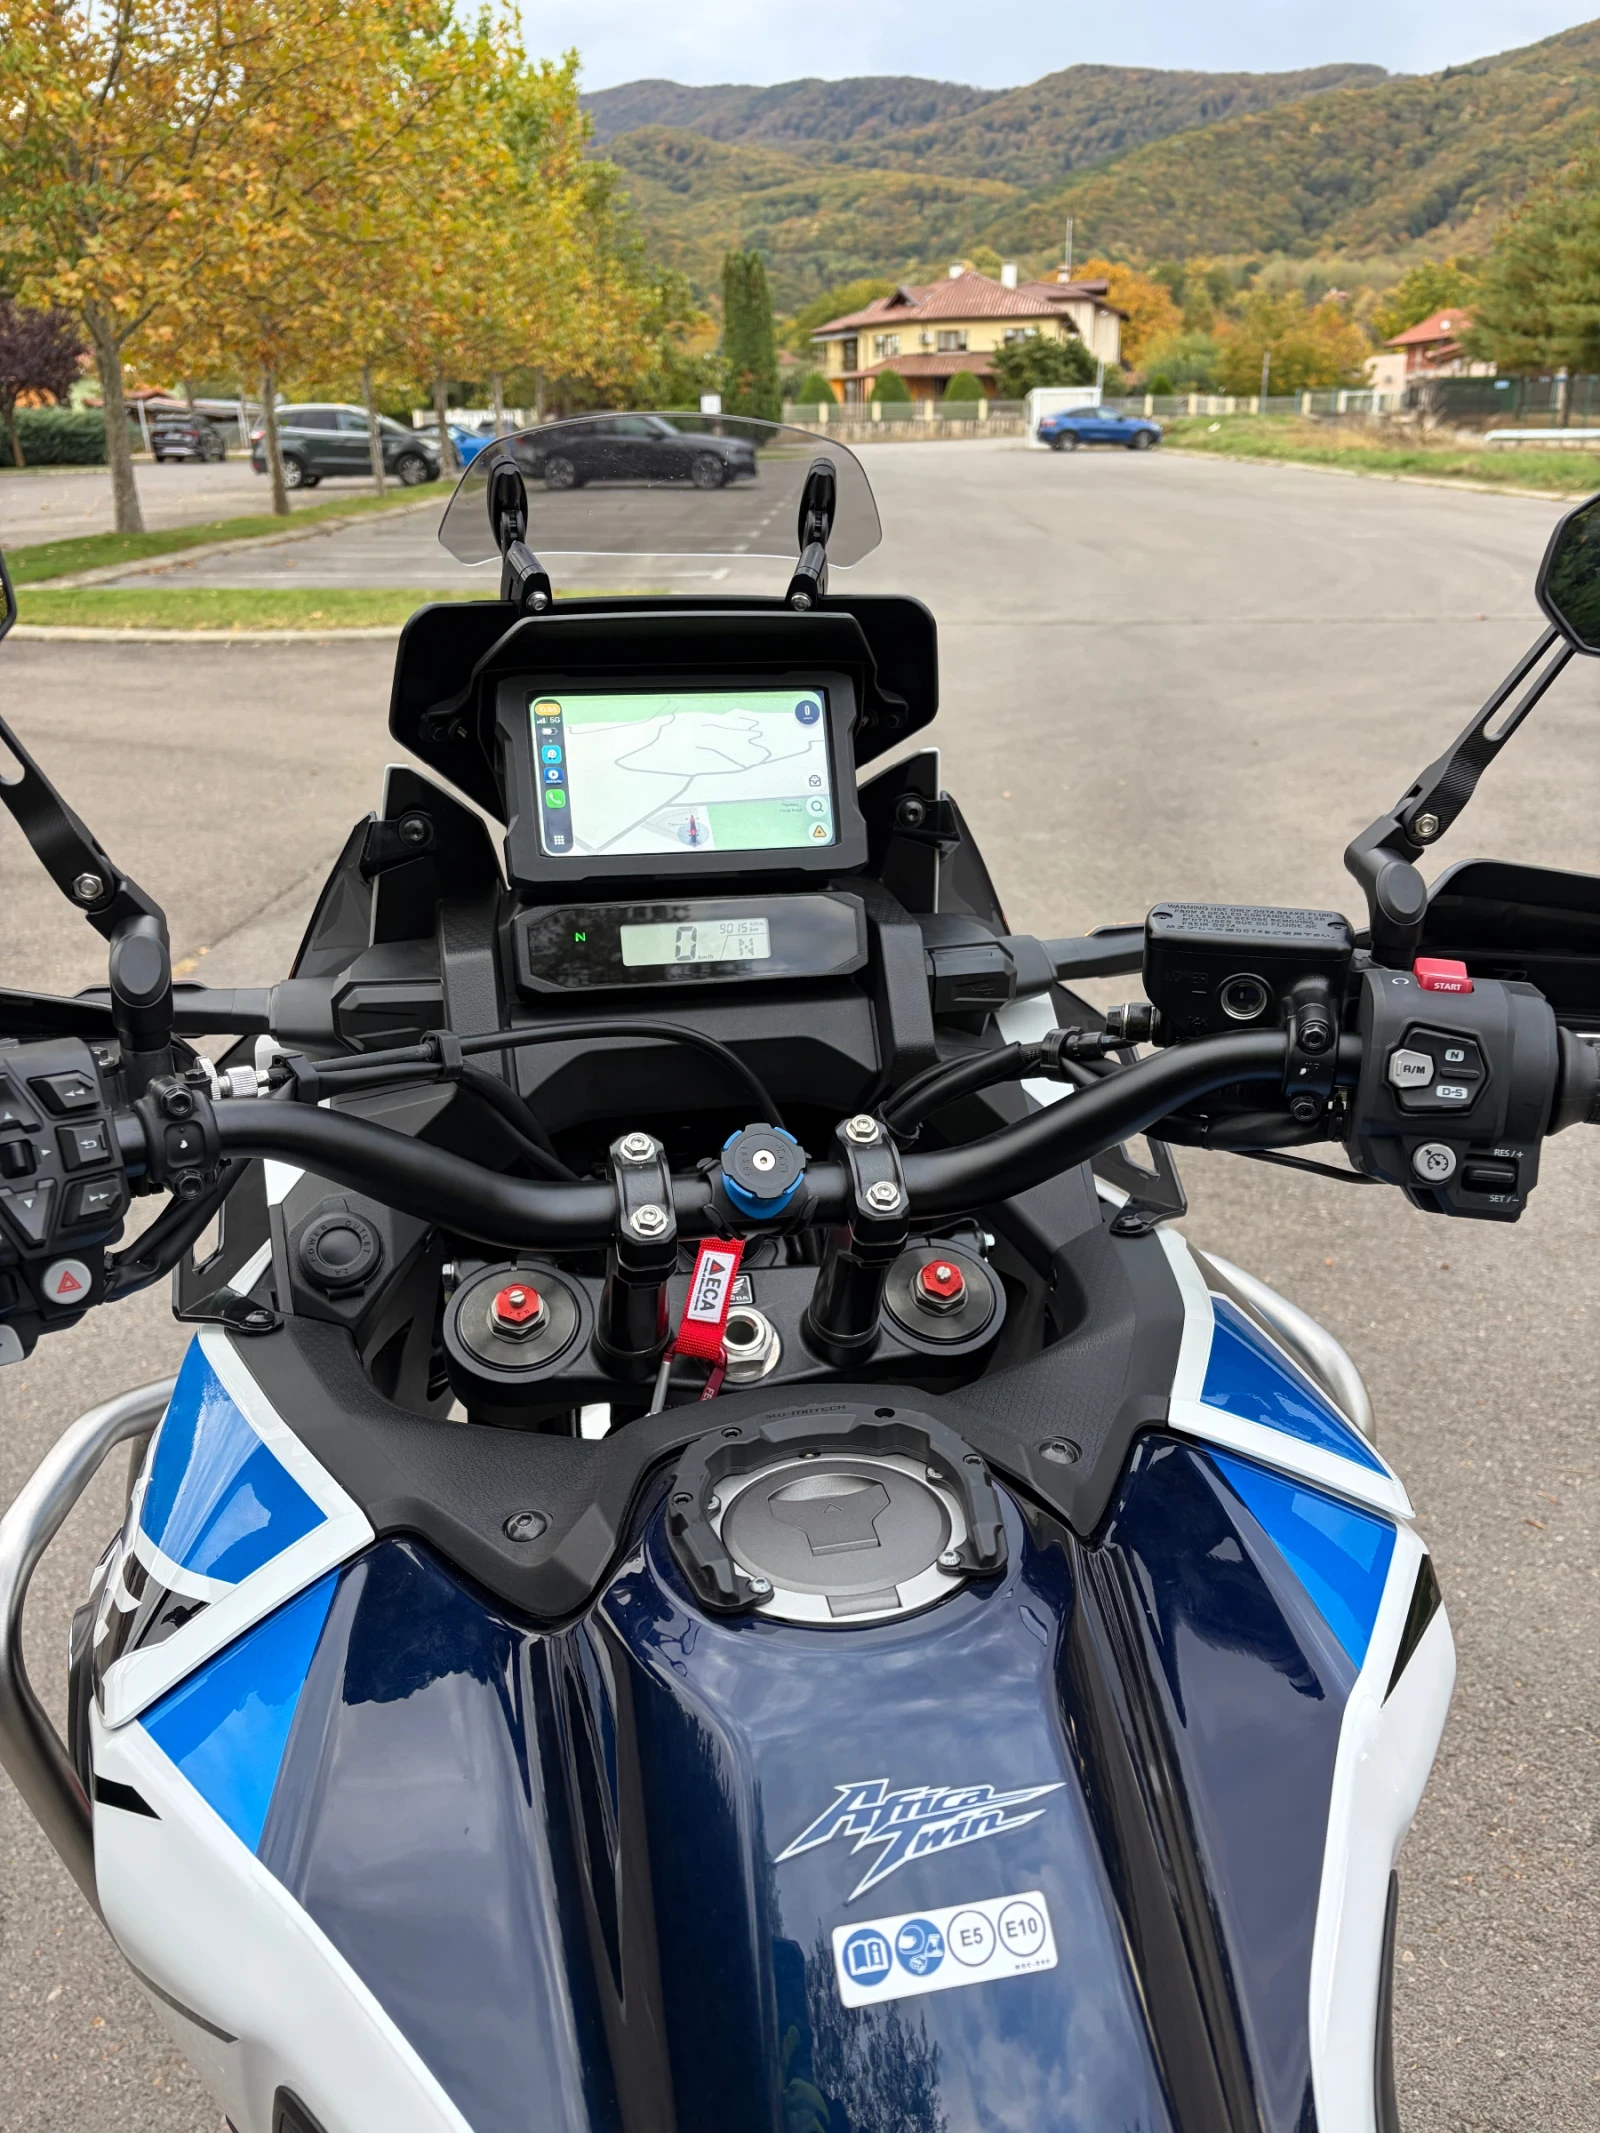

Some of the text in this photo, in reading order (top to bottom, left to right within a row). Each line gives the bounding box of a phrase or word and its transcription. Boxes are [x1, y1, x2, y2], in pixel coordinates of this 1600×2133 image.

[804, 705, 811, 716] 0
[549, 716, 561, 724] 5G
[719, 923, 748, 934] 9015
[575, 932, 587, 943] N
[675, 925, 698, 962] 0
[1433, 982, 1462, 991] START
[1450, 1051, 1460, 1060] N
[307, 1220, 371, 1263] POWER OUTLET
[774, 1777, 1067, 1863] Africa
[846, 1808, 1047, 1902] Twin
[1005, 1917, 1038, 1939] E10
[960, 1927, 984, 1948] E5
